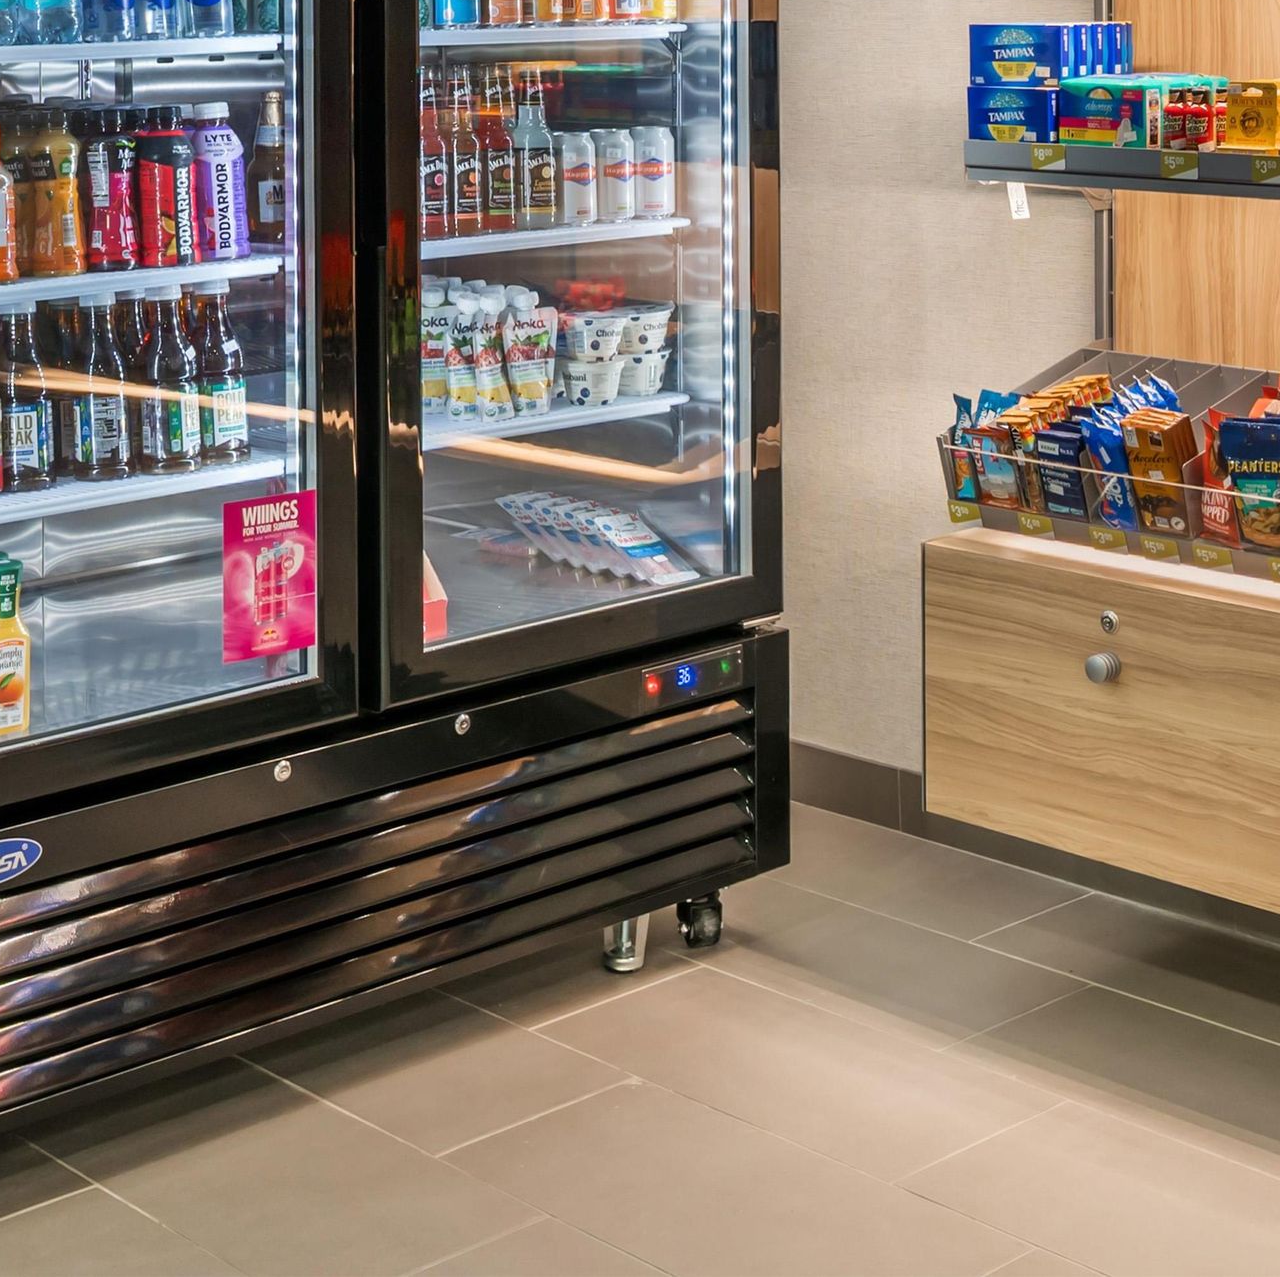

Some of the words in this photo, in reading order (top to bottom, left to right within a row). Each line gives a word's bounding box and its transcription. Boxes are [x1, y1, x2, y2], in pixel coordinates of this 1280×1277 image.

[993, 45, 1035, 61] TAMPAX
[204, 132, 232, 145] LYTE
[178, 166, 190, 257] BODYARMOR
[219, 162, 231, 250] BODYARMOR
[242, 500, 298, 527] WIIINGS
[243, 526, 255, 537] FOR
[256, 524, 271, 534] YOUR
[273, 520, 299, 532] SUMMER.
[678, 668, 690, 685] 36
